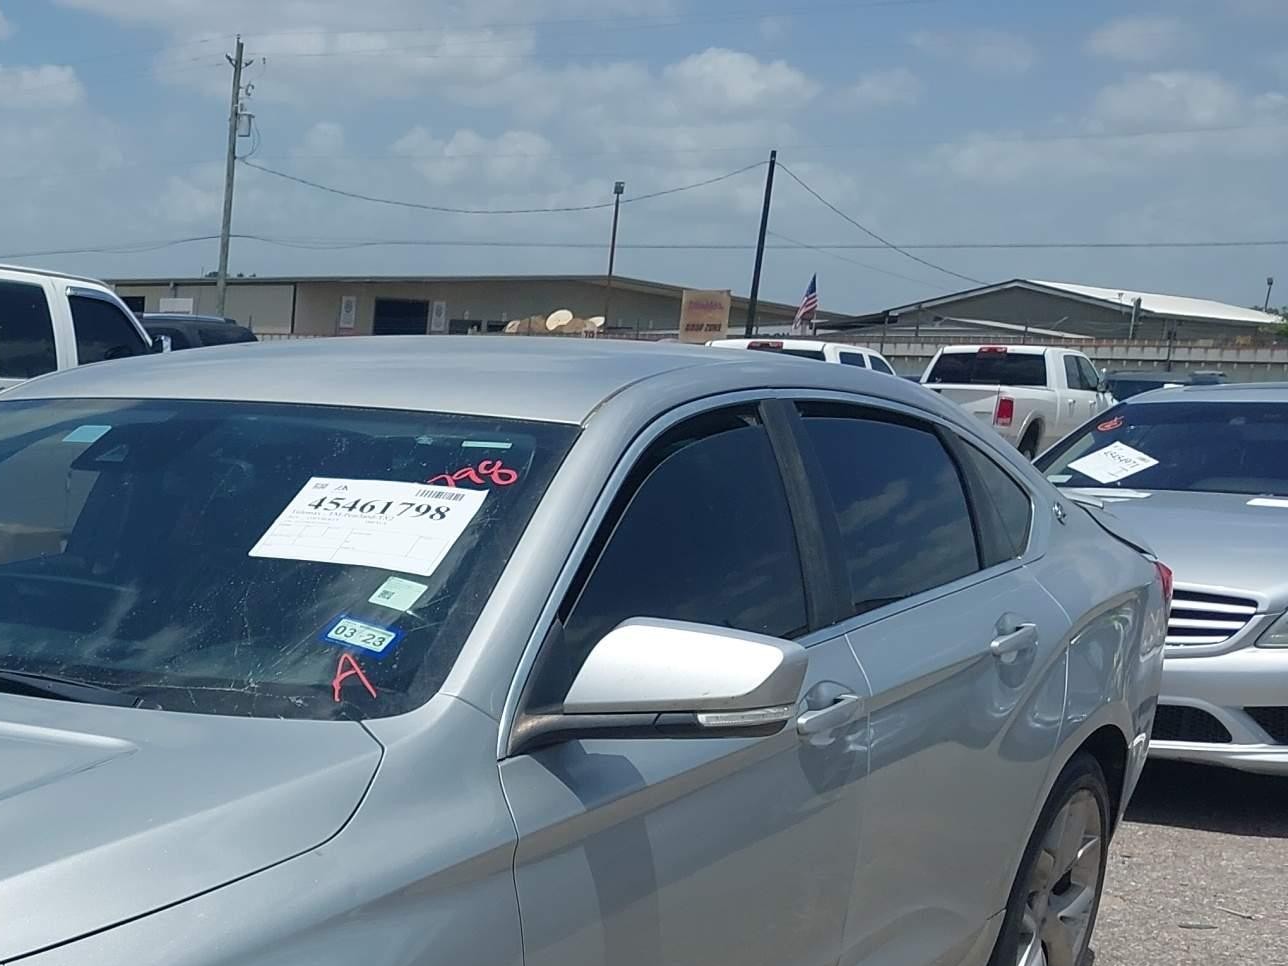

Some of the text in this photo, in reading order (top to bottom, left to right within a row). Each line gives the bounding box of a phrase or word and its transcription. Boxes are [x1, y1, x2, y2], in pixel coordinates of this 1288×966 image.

[307, 496, 451, 521] 45461798
[334, 625, 386, 648] 03 23
[331, 652, 378, 703] A
